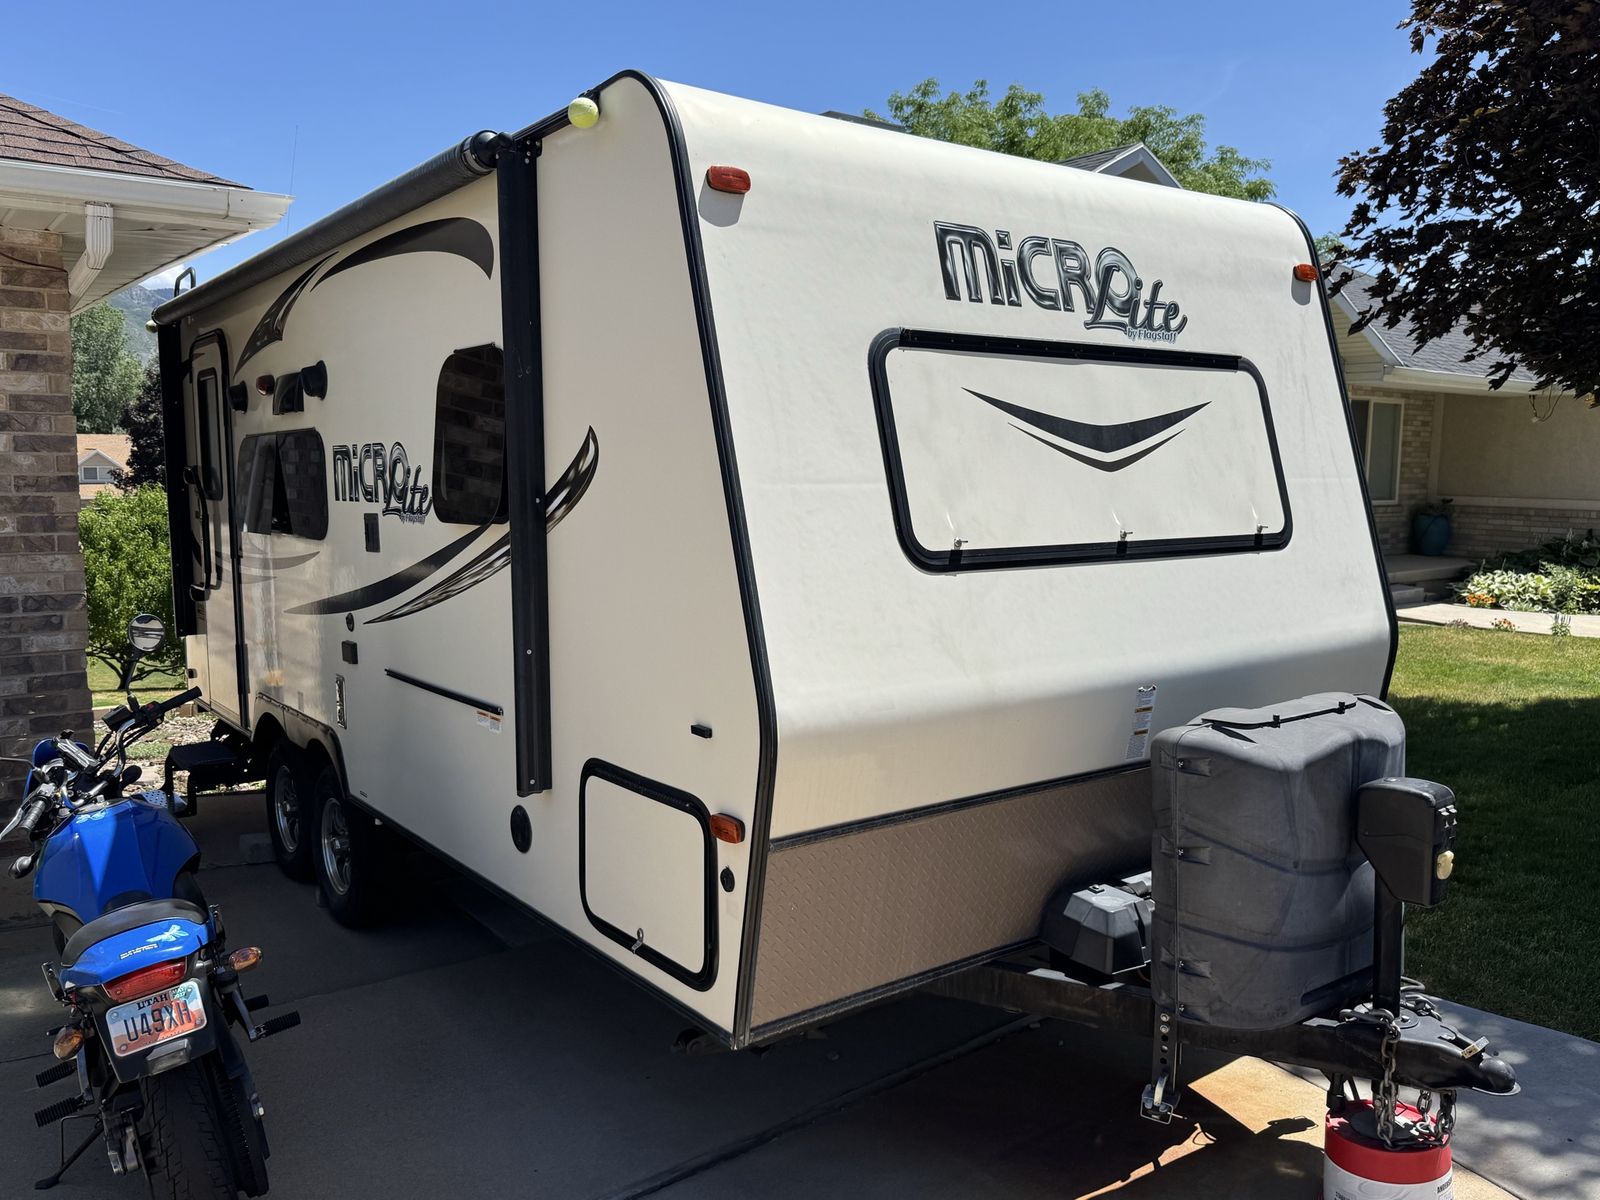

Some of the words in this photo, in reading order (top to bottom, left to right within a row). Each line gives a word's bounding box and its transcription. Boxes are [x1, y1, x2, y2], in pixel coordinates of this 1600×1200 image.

[1083, 265, 1188, 334] Lite
[1127, 327, 1138, 341] by
[1138, 329, 1177, 344] Flagstaff
[382, 458, 433, 517] Lite
[123, 999, 192, 1042] U49XH
[136, 993, 169, 1011] UTAH
